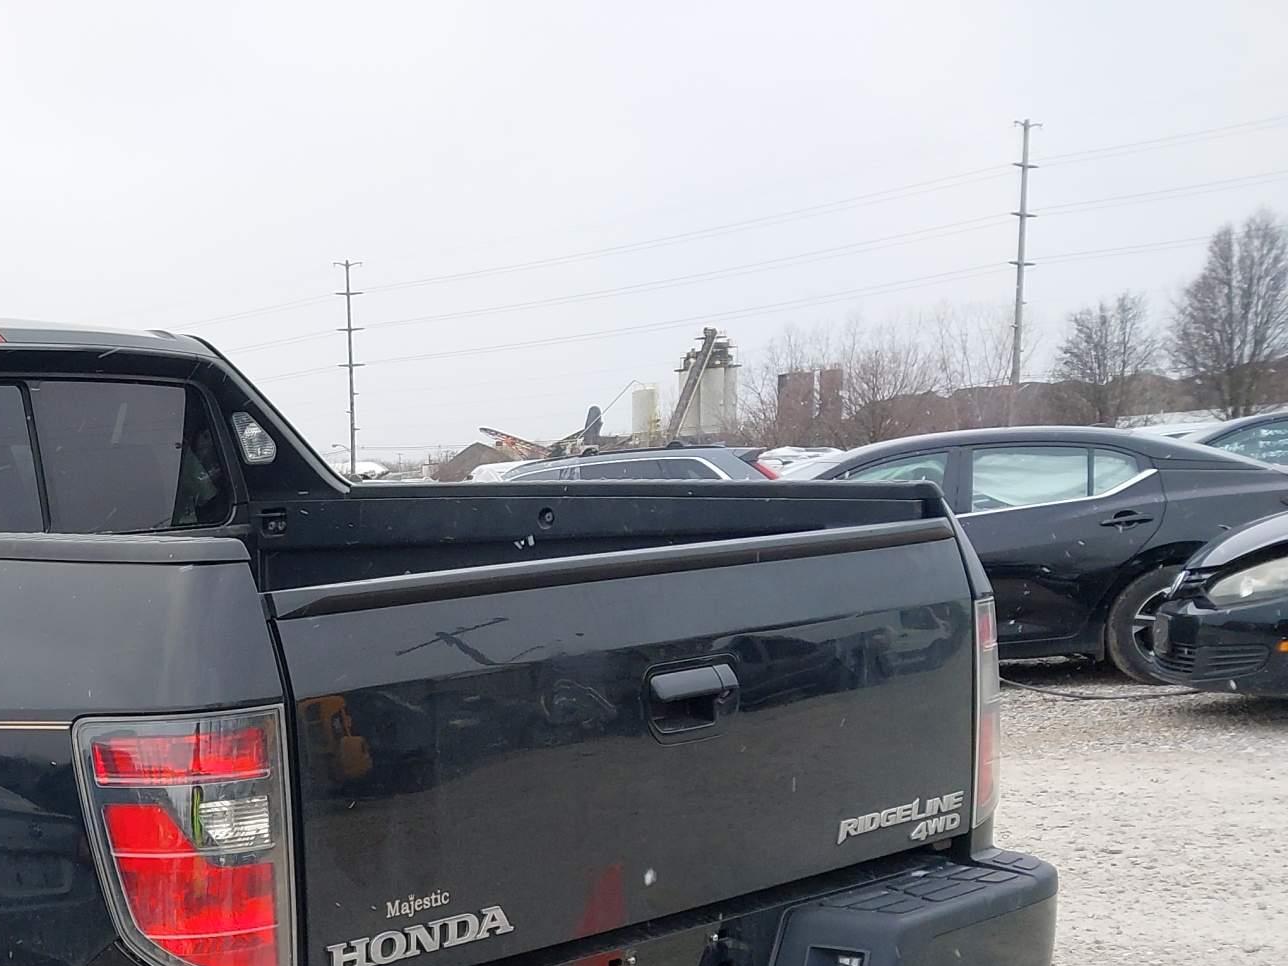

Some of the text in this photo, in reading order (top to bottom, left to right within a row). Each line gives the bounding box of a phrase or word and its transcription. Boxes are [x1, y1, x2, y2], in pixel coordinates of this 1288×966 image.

[836, 790, 964, 845] RIDGELINE
[910, 812, 961, 841] 4WD
[385, 889, 450, 919] Majestic
